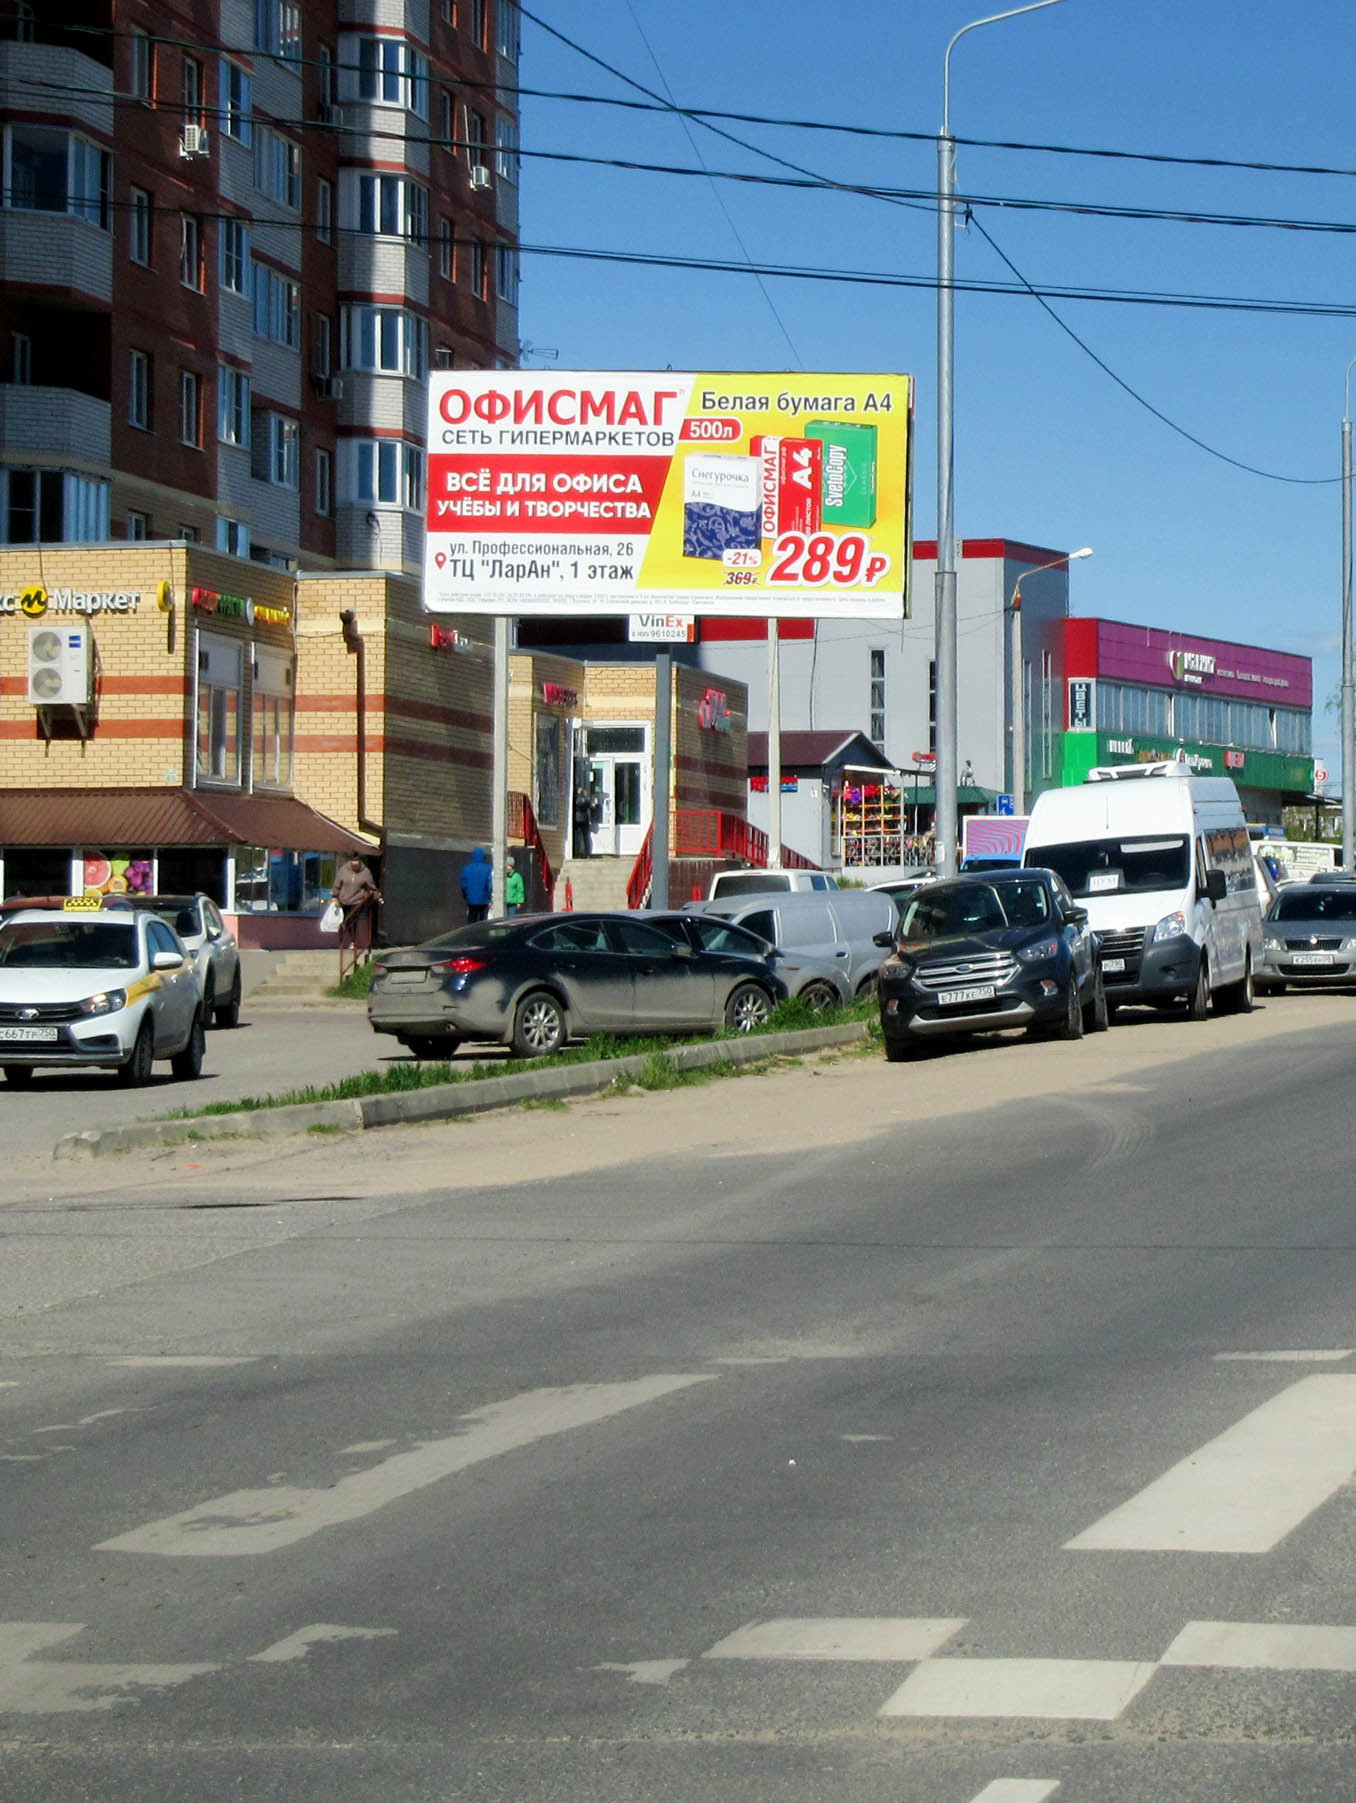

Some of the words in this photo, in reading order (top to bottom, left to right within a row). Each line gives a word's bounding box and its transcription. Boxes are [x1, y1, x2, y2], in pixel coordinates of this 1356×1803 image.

[439, 389, 678, 426] ОФИСМАГ
[702, 391, 769, 410] Белая
[777, 392, 855, 415] бумага
[442, 430, 492, 445] СЕТЬ
[499, 430, 675, 447] ГИПЕРМАРКЕТОВ
[689, 421, 733, 438] 500л
[446, 468, 491, 492] ВСЁ
[497, 473, 545, 494] ДЛЯ
[553, 472, 643, 494] ОФИСА
[691, 467, 750, 483] Снегурочка
[825, 444, 847, 507] SvetoCopy
[763, 445, 777, 533] ОФИСМАГ
[437, 497, 501, 516] УЧЁБЫ
[507, 501, 520, 516] И
[525, 501, 652, 519] ТВОРЧЕСТВА
[450, 543, 468, 558] ул.
[472, 540, 613, 557] Профессиональная,
[617, 542, 634, 556] 26
[450, 559, 475, 581] ТЦ
[571, 561, 579, 578] 1
[587, 564, 634, 580] этаж
[53, 588, 141, 614] Маркет
[1075, 684, 1088, 729] ЦВЕТЫ
